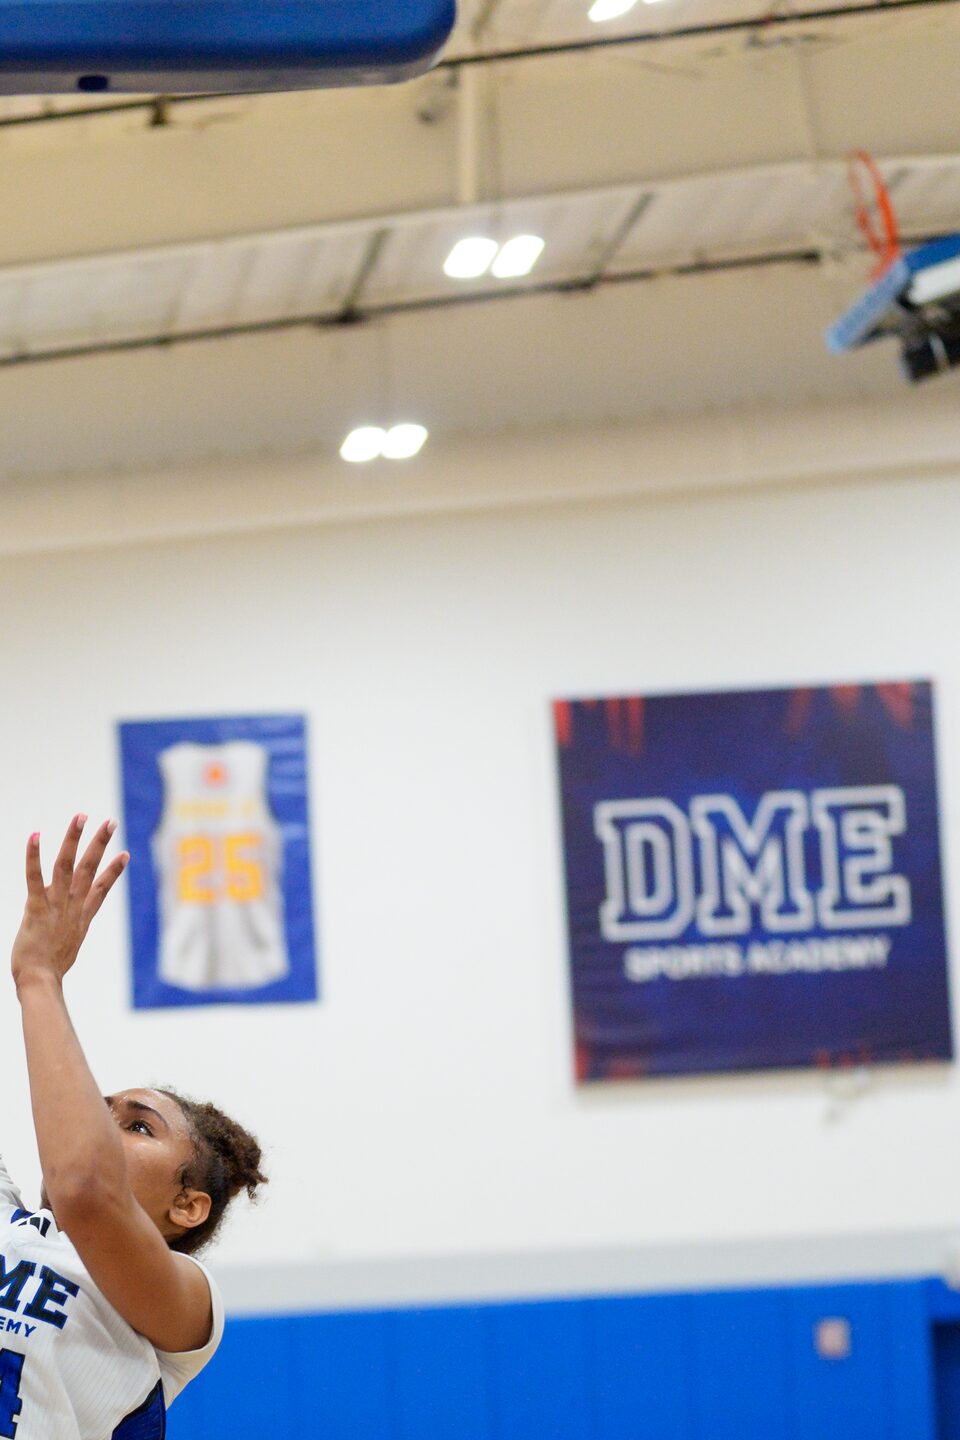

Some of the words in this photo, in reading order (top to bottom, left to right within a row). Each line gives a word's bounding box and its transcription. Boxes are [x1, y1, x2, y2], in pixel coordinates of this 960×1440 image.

[175, 832, 267, 905] 25
[594, 785, 912, 941] DME
[624, 943, 741, 982] SPORTS
[746, 934, 889, 975] ACADEMY
